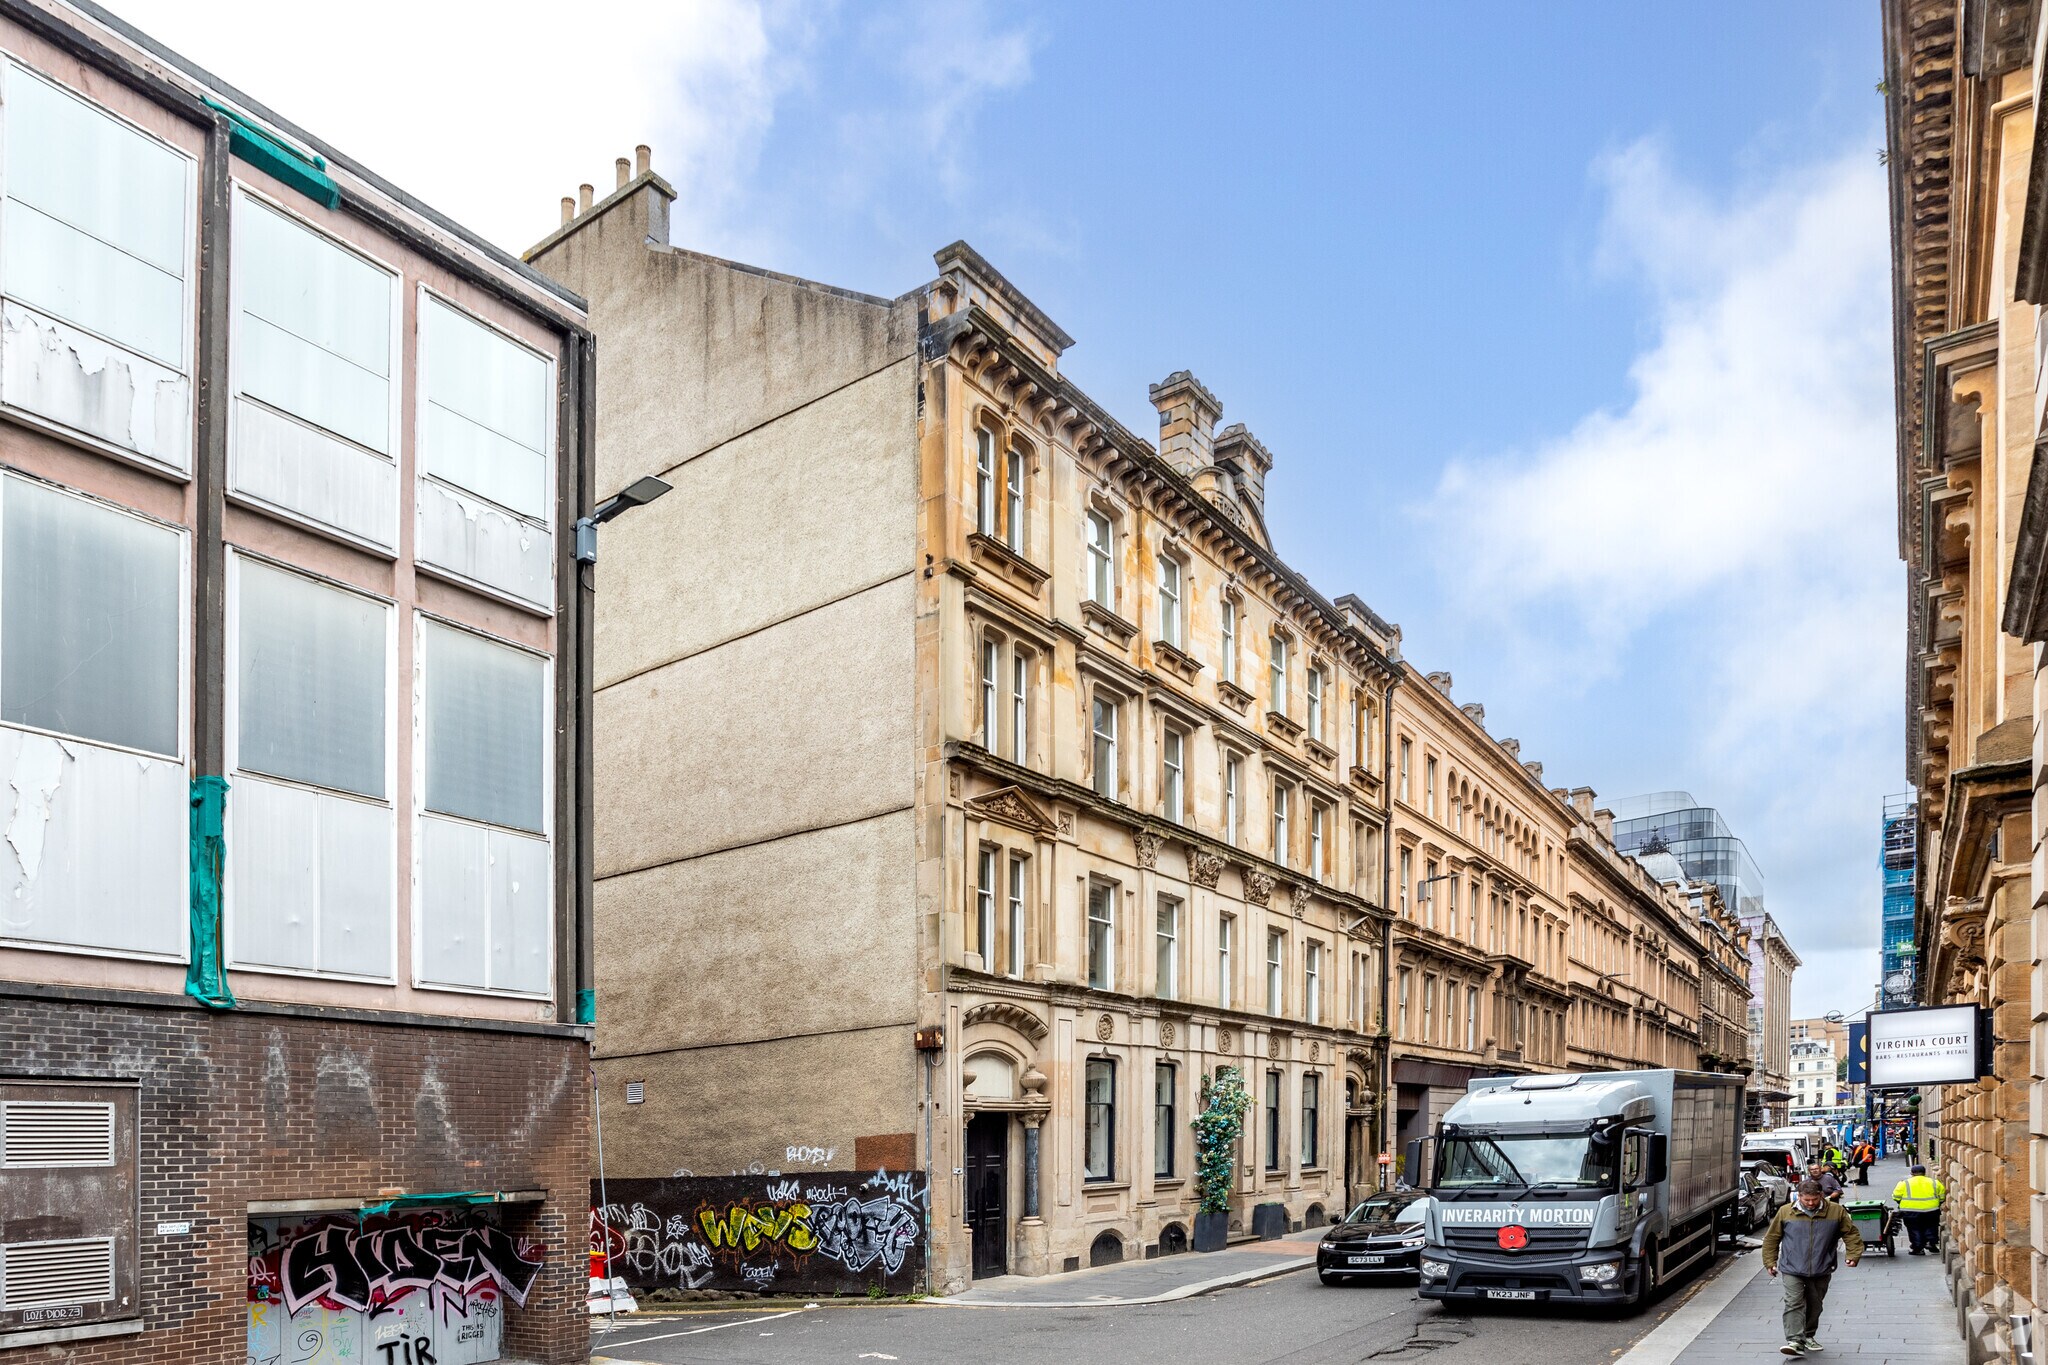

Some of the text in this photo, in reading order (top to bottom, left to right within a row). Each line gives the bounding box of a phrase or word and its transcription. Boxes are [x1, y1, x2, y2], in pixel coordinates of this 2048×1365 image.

[1876, 1036, 1968, 1050] VIRGINIA COURT
[1442, 1208, 1594, 1223] INVERARITY MORTON
[1491, 1290, 1513, 1298] YK23
[461, 1330, 484, 1340] RIGGED
